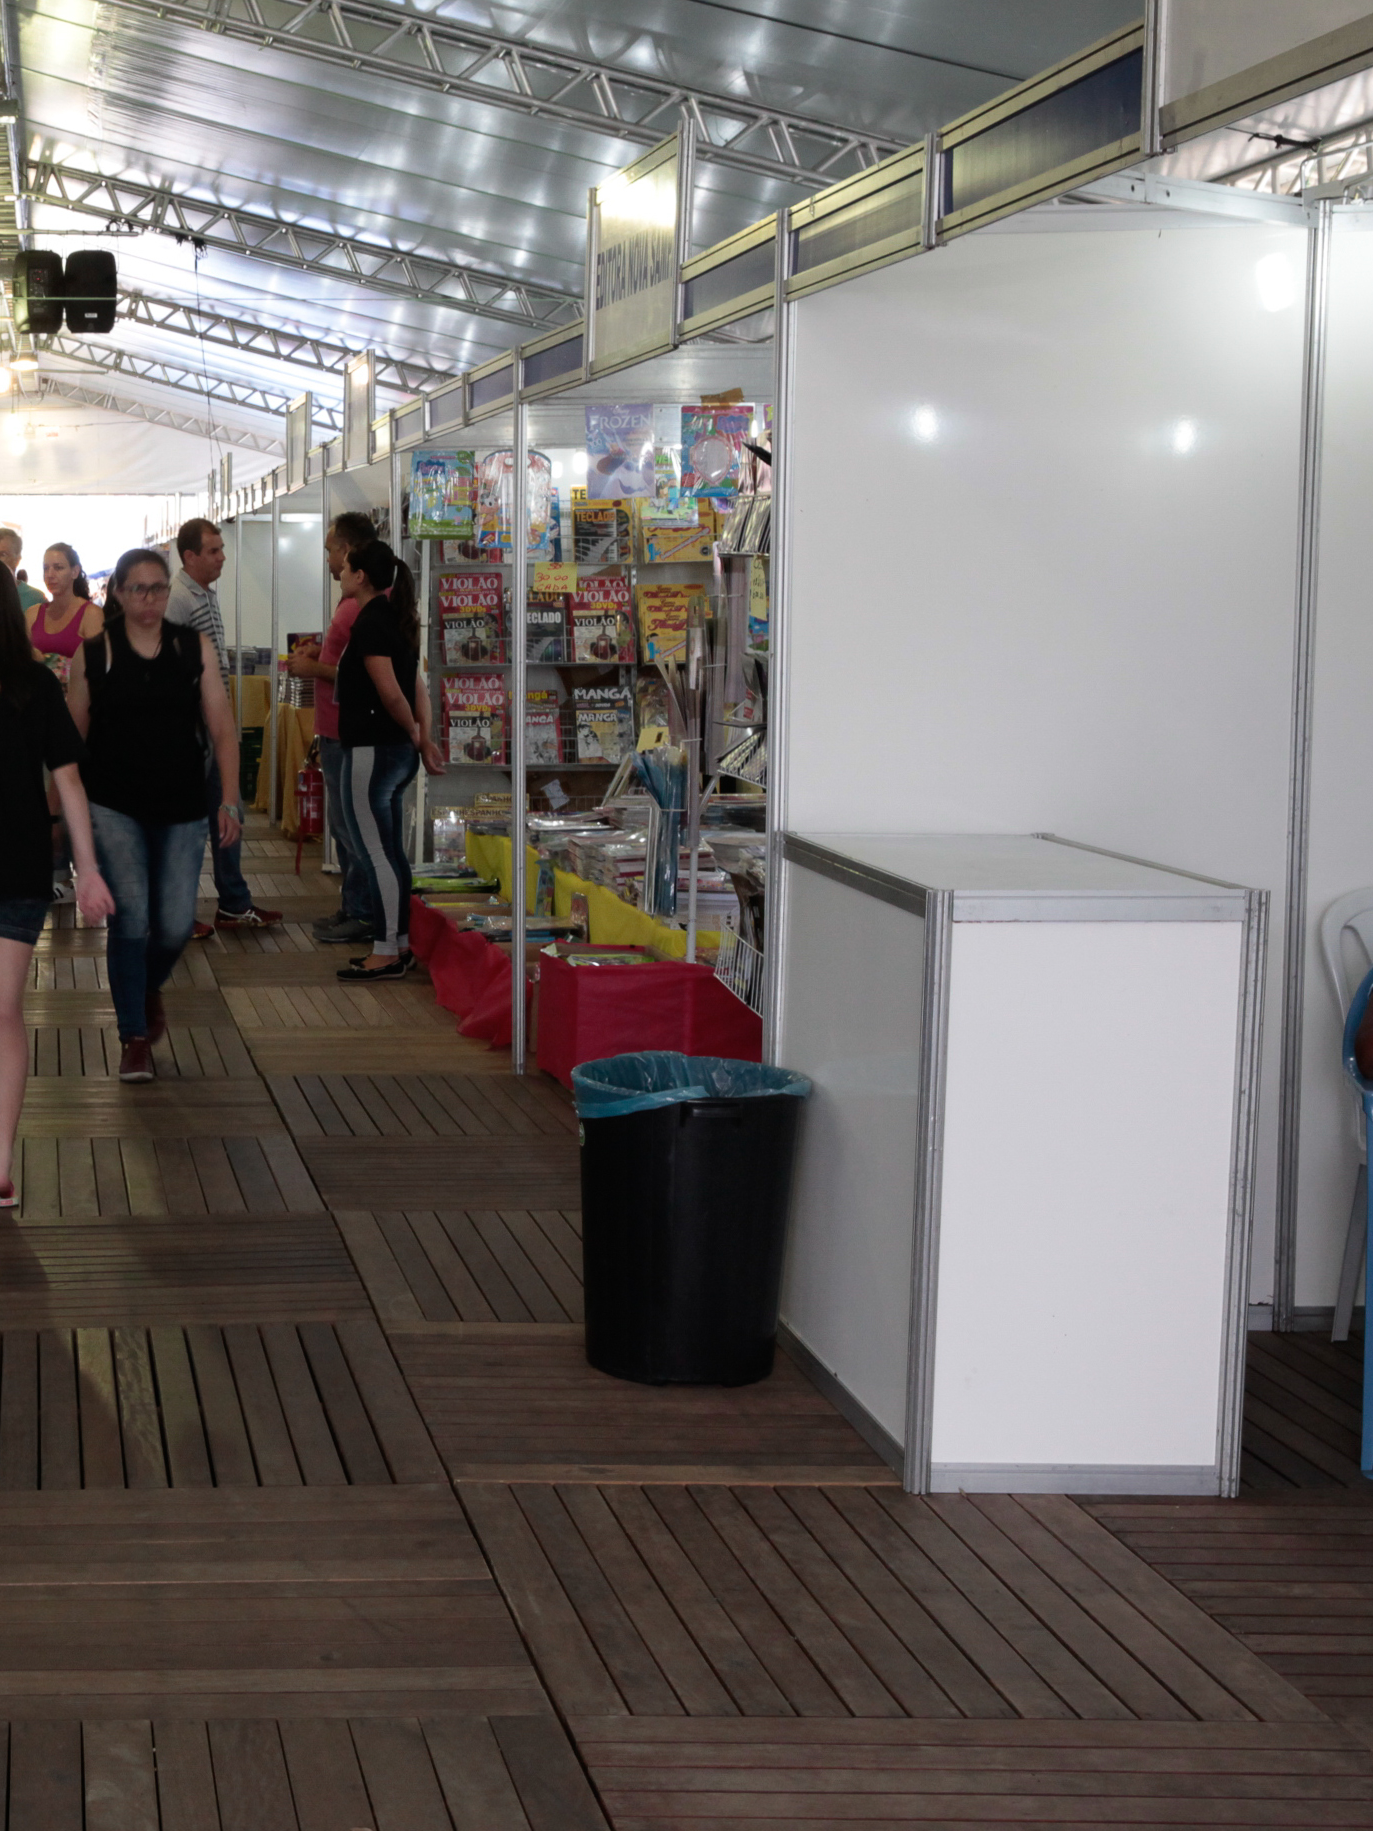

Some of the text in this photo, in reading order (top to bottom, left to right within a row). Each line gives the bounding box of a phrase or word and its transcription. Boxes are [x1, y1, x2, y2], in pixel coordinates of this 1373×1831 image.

[589, 414, 651, 431] FROZEN
[441, 593, 498, 607] VIOLÃO
[572, 587, 630, 602] VIOLÃO
[444, 618, 485, 629] VIOLÃO
[527, 612, 562, 624] ECLADO
[574, 617, 615, 626] VIOLÃO
[446, 691, 504, 705] VIOLÃO
[450, 717, 490, 728] VIOLÃO
